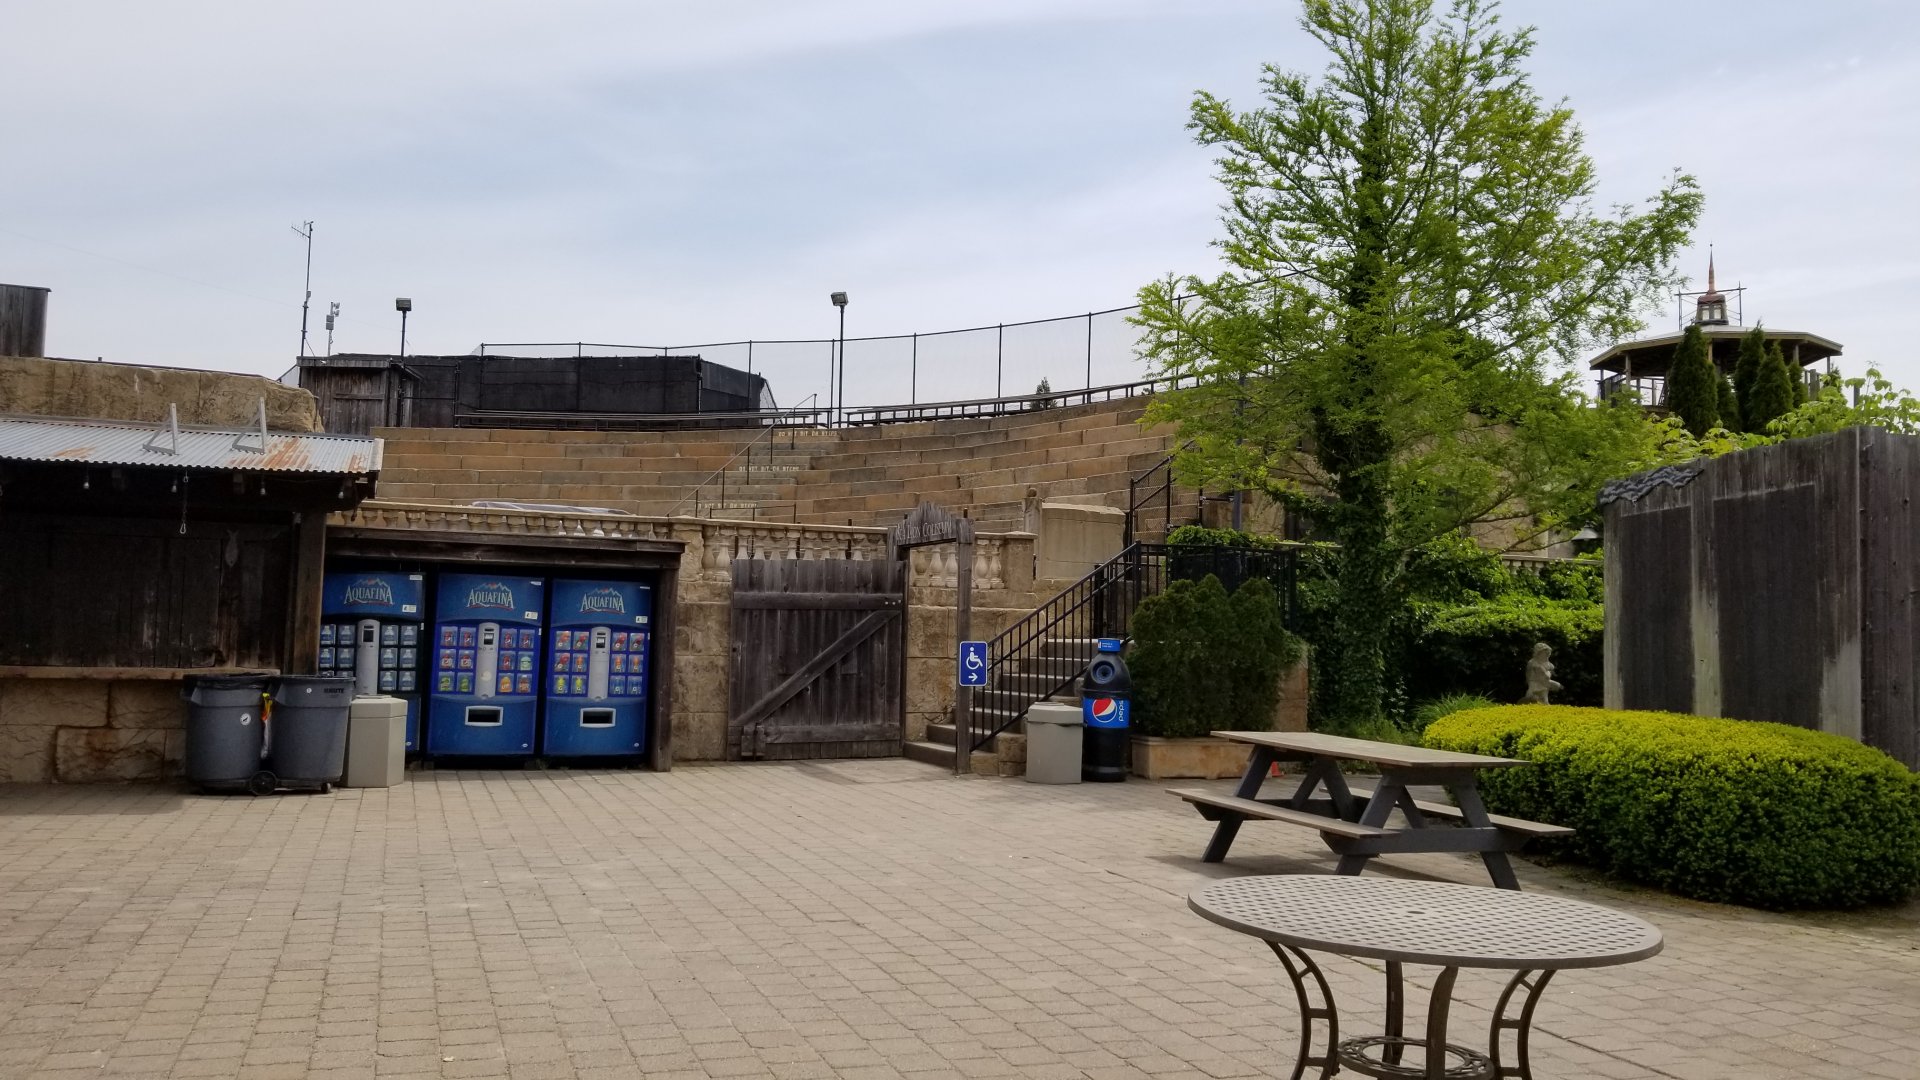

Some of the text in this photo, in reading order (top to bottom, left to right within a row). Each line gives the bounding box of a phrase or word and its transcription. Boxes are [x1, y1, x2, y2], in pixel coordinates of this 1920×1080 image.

[344, 585, 393, 605] AQUAFINA
[467, 588, 514, 608] AQUAFINA
[580, 593, 625, 613] AQUAFINA
